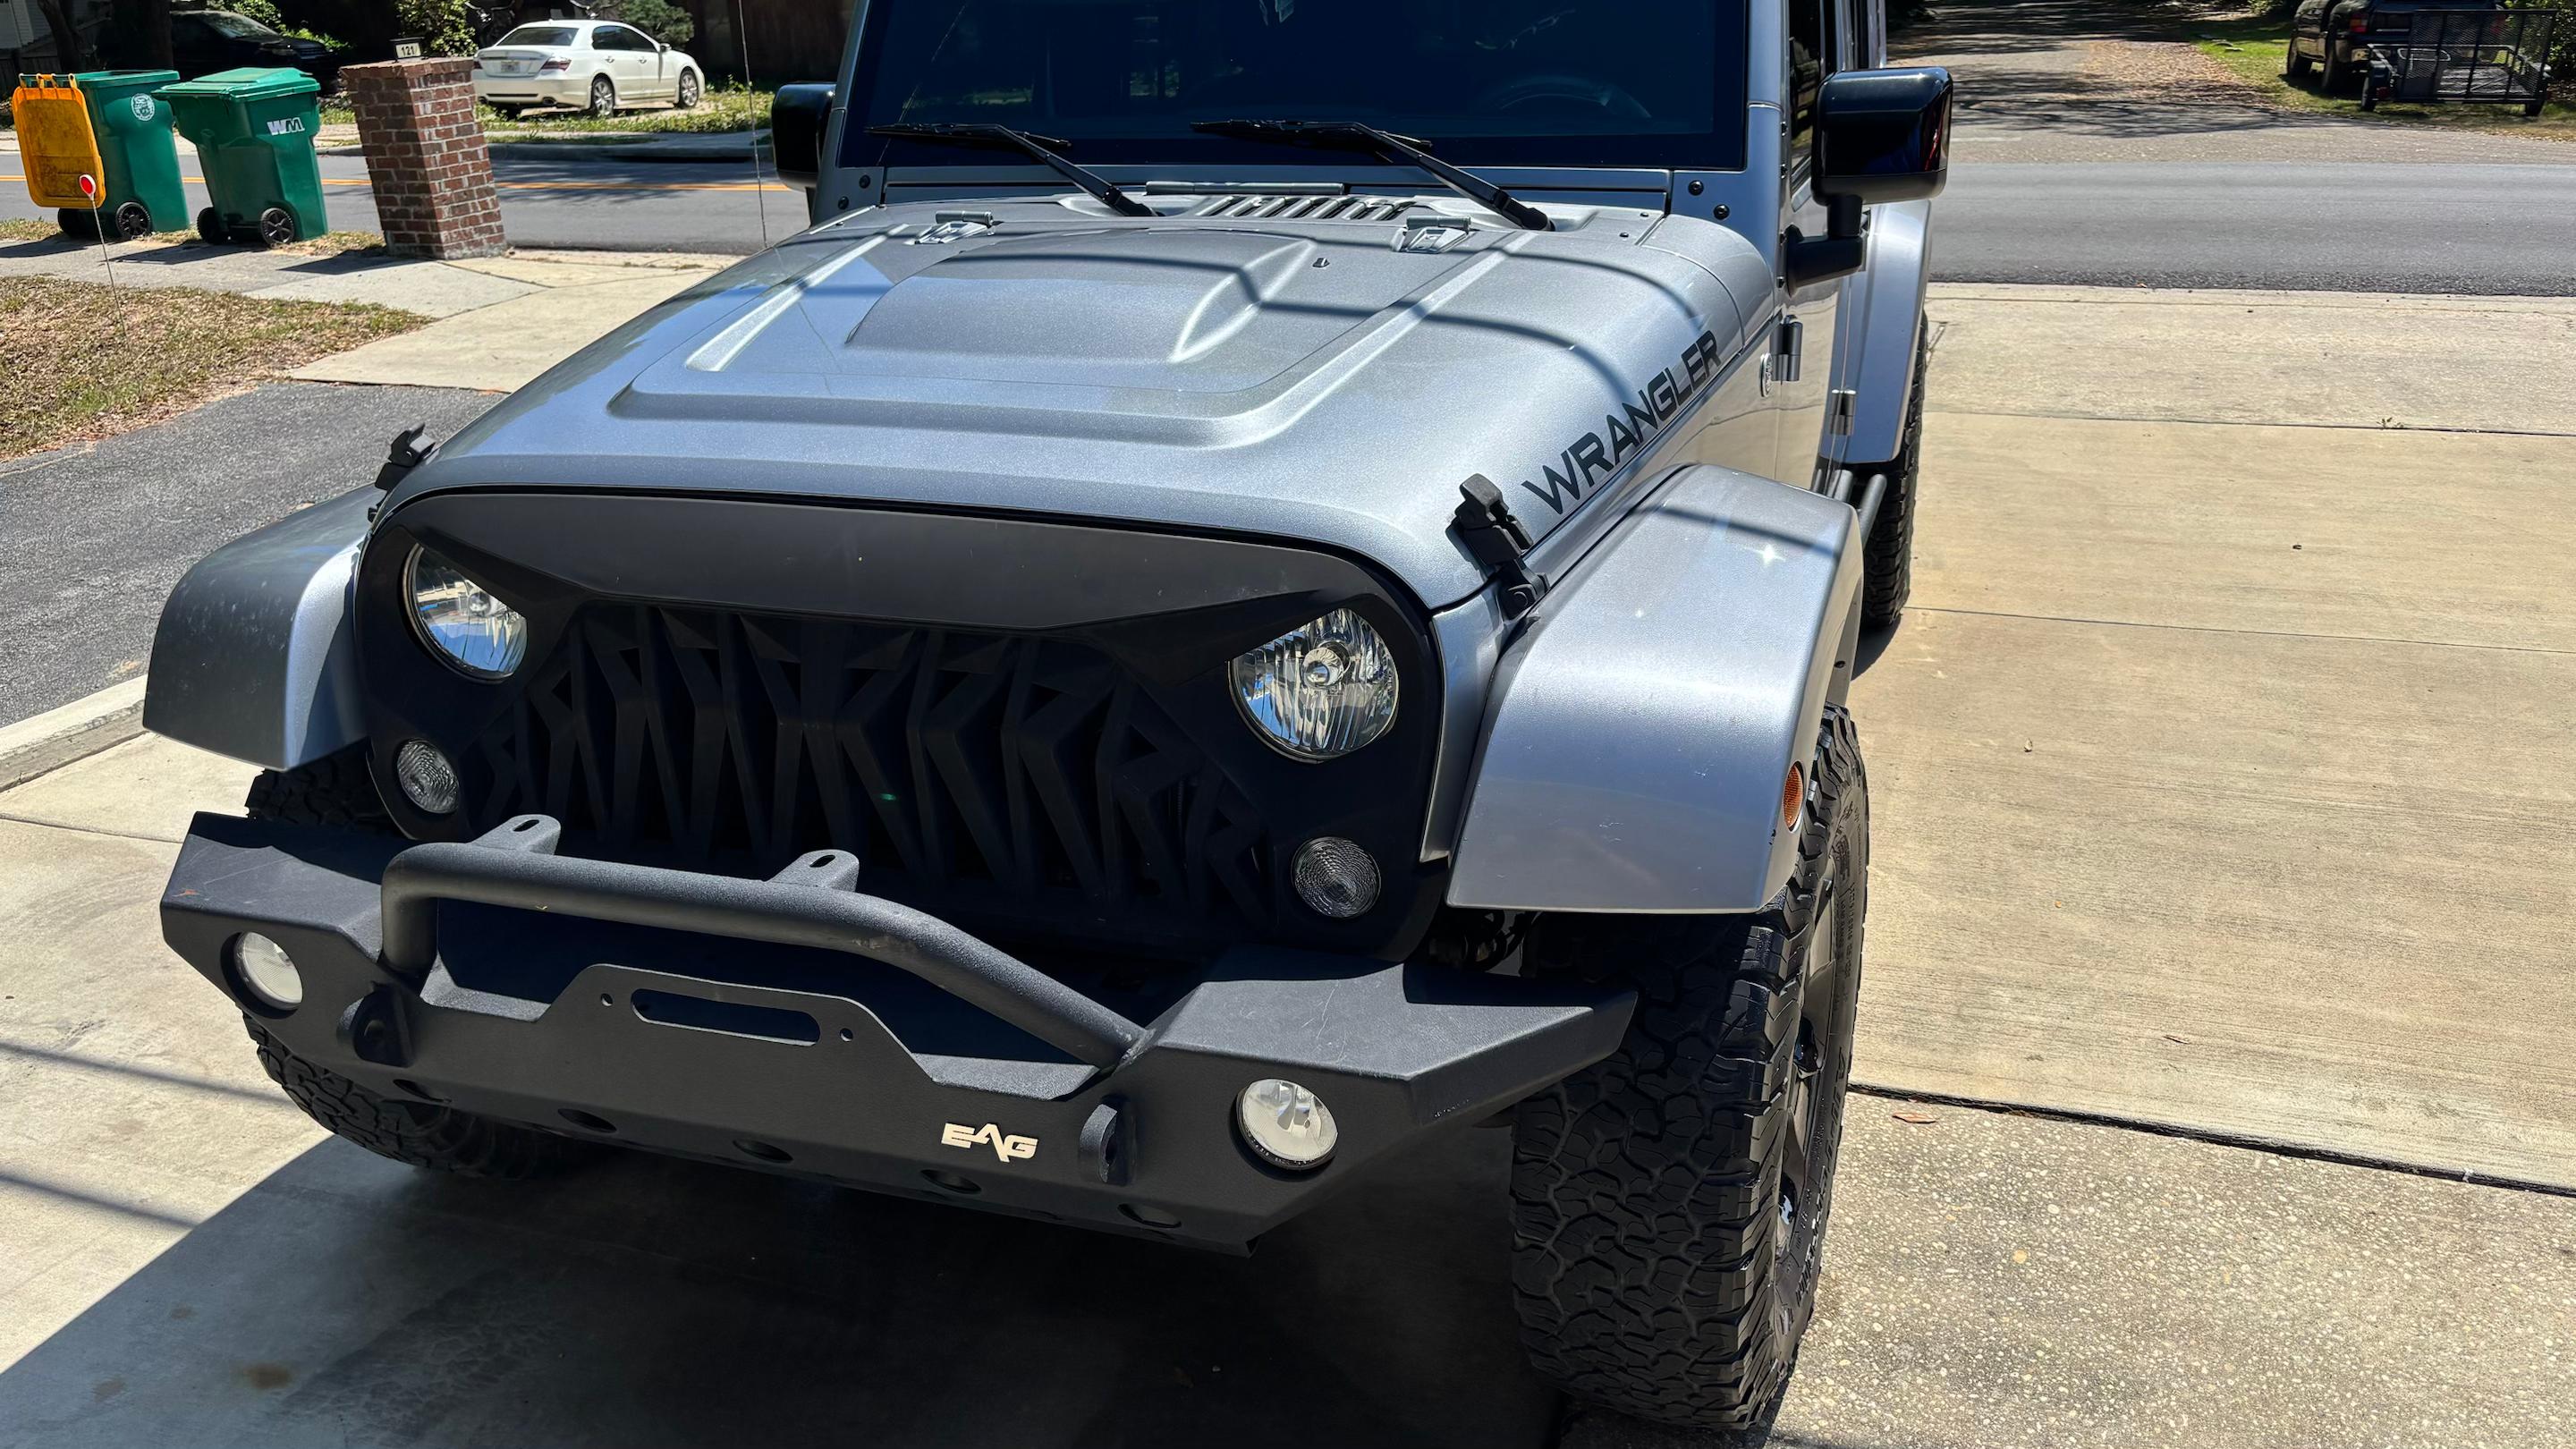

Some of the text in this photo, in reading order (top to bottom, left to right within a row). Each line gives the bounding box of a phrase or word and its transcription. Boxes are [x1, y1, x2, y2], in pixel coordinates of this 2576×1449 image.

[267, 117, 305, 135] WM
[1521, 330, 1721, 515] WRANGLER
[941, 1123, 1038, 1163] EAG
